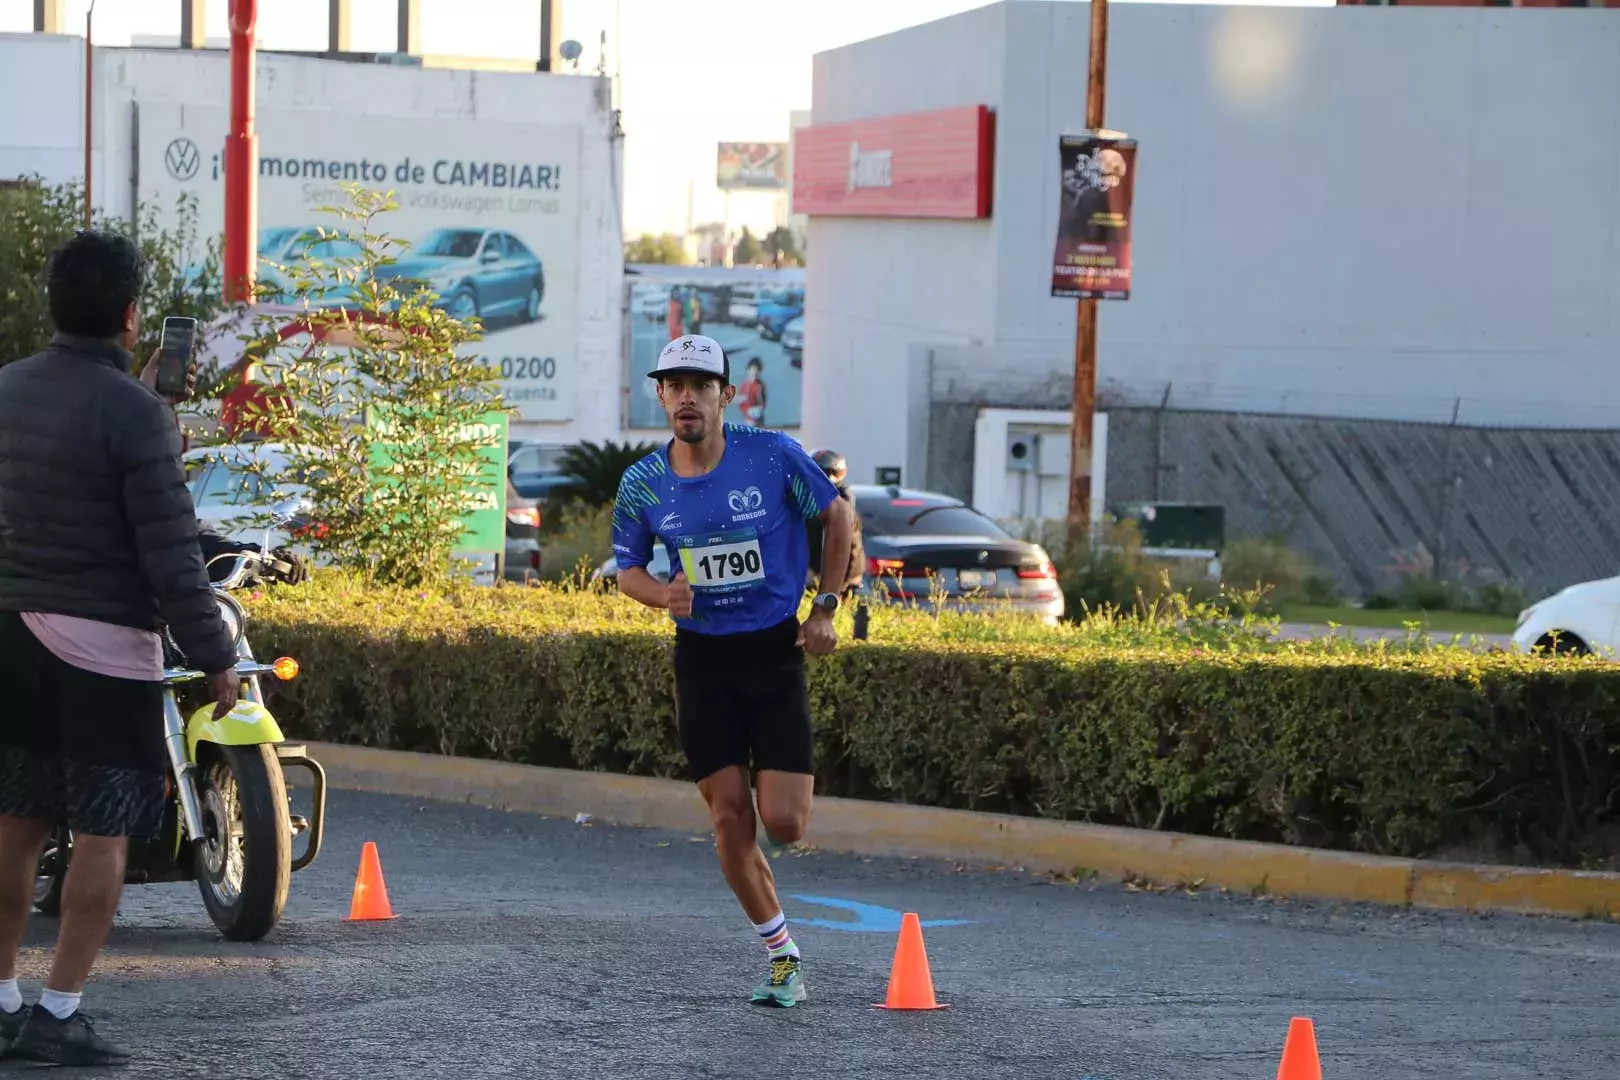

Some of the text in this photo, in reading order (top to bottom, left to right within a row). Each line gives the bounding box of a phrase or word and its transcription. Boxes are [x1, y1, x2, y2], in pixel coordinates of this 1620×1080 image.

[259, 157, 387, 182] momento
[395, 157, 425, 184] de
[433, 160, 560, 190] CAMBIAR!
[407, 191, 503, 214] Volkswagen
[501, 356, 556, 380] 0200
[732, 508, 767, 522] BORREGOS
[699, 549, 760, 580] 1790
